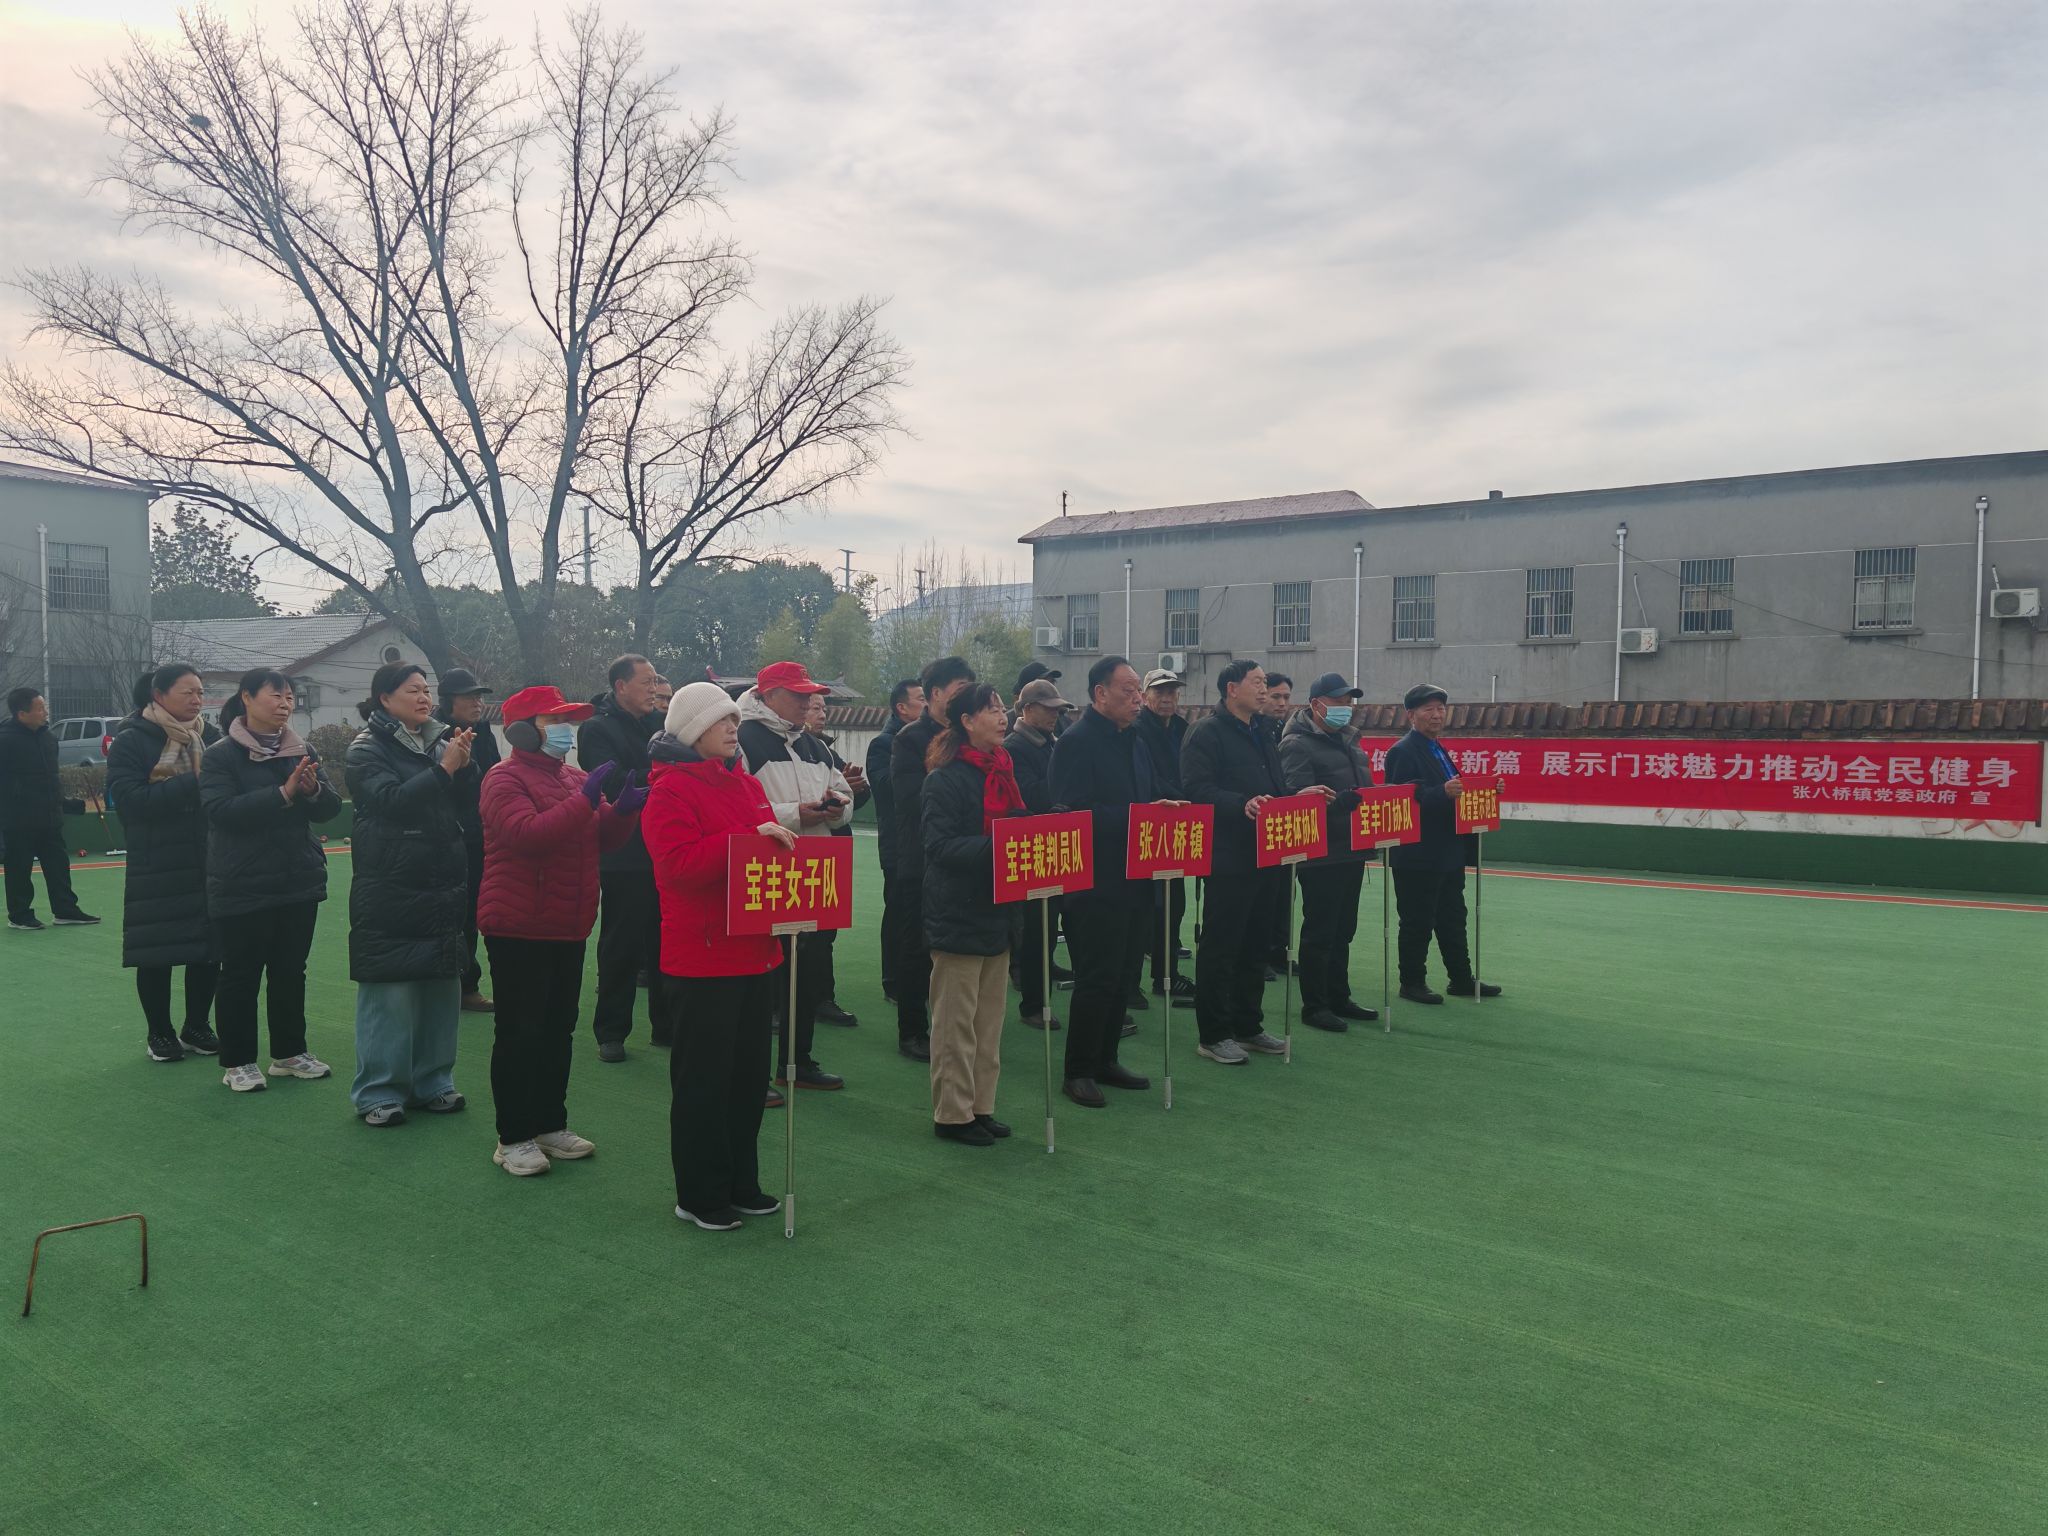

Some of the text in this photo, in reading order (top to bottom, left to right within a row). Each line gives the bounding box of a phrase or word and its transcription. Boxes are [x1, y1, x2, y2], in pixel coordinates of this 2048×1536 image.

[1540, 751, 2018, 787] 展示门球魅力推动全民健身
[1792, 785, 1991, 805] 张八桥镇党委政府 宣
[1265, 808, 1320, 850] 宝丰老体协队
[1360, 797, 1413, 835] 宝丰门协队
[1006, 829, 1083, 882] 宝丰裁判员队
[1139, 820, 1204, 861] 张八桥镇
[745, 856, 838, 911] 宝丰女子队
